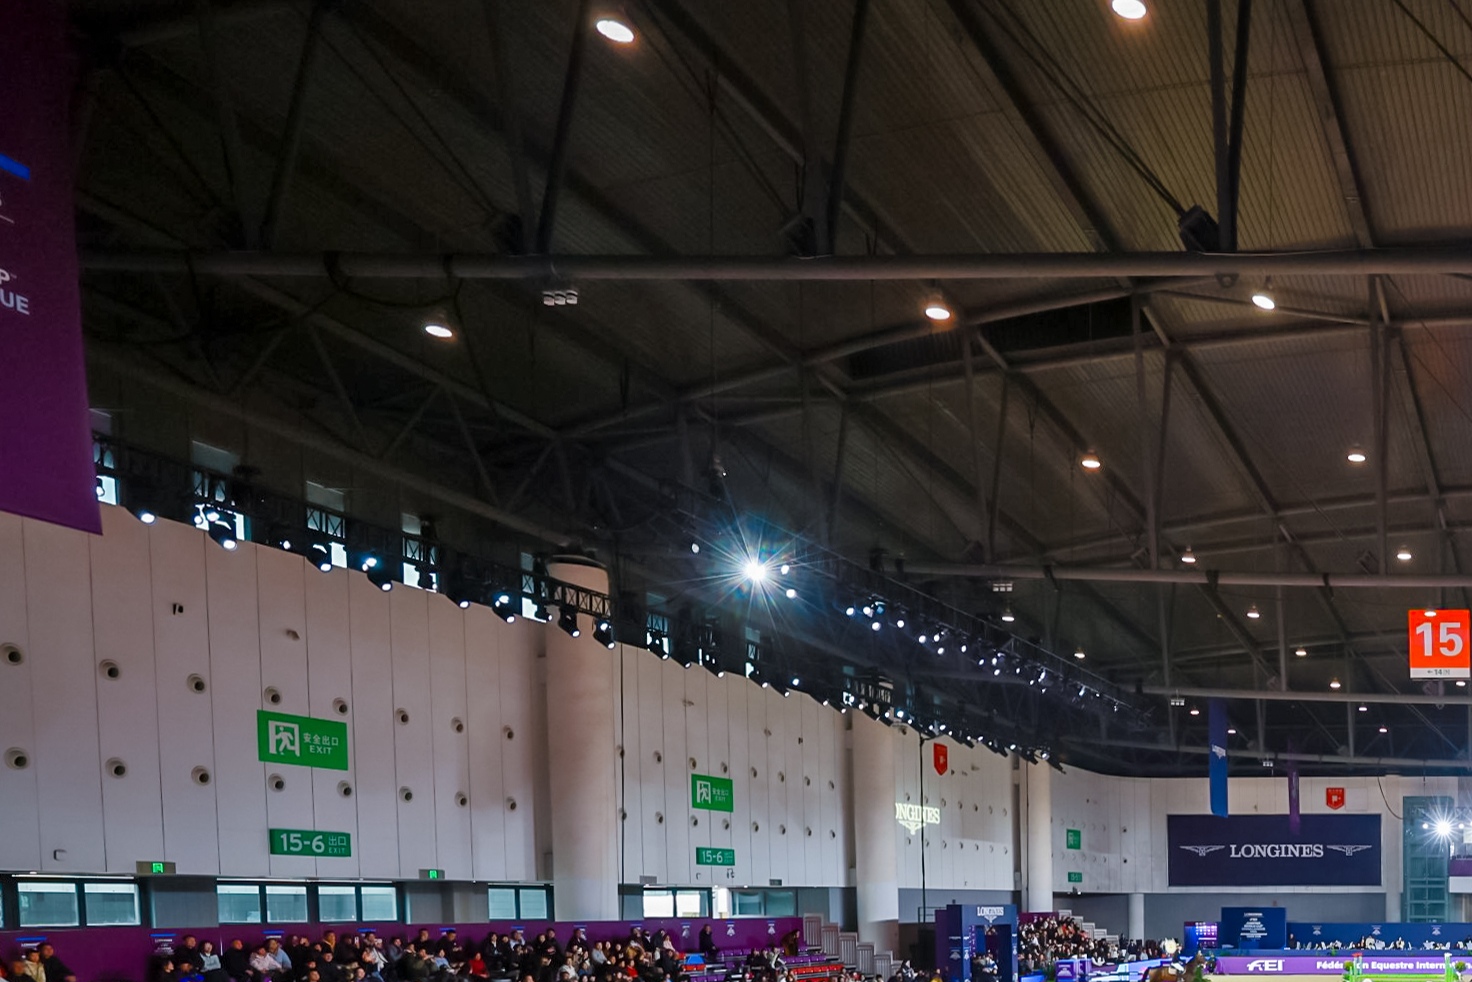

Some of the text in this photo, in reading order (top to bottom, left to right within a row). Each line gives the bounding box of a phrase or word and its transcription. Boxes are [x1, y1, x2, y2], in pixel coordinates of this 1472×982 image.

[1416, 622, 1463, 657] 15
[303, 732, 339, 746] 安全出口
[309, 745, 332, 755] EXIT
[281, 833, 347, 853] 15-6 出口
[702, 850, 723, 863] 15-6
[1229, 844, 1324, 858] LONGINES
[1246, 959, 1284, 971] FEI
[1371, 961, 1414, 971] Equestre
